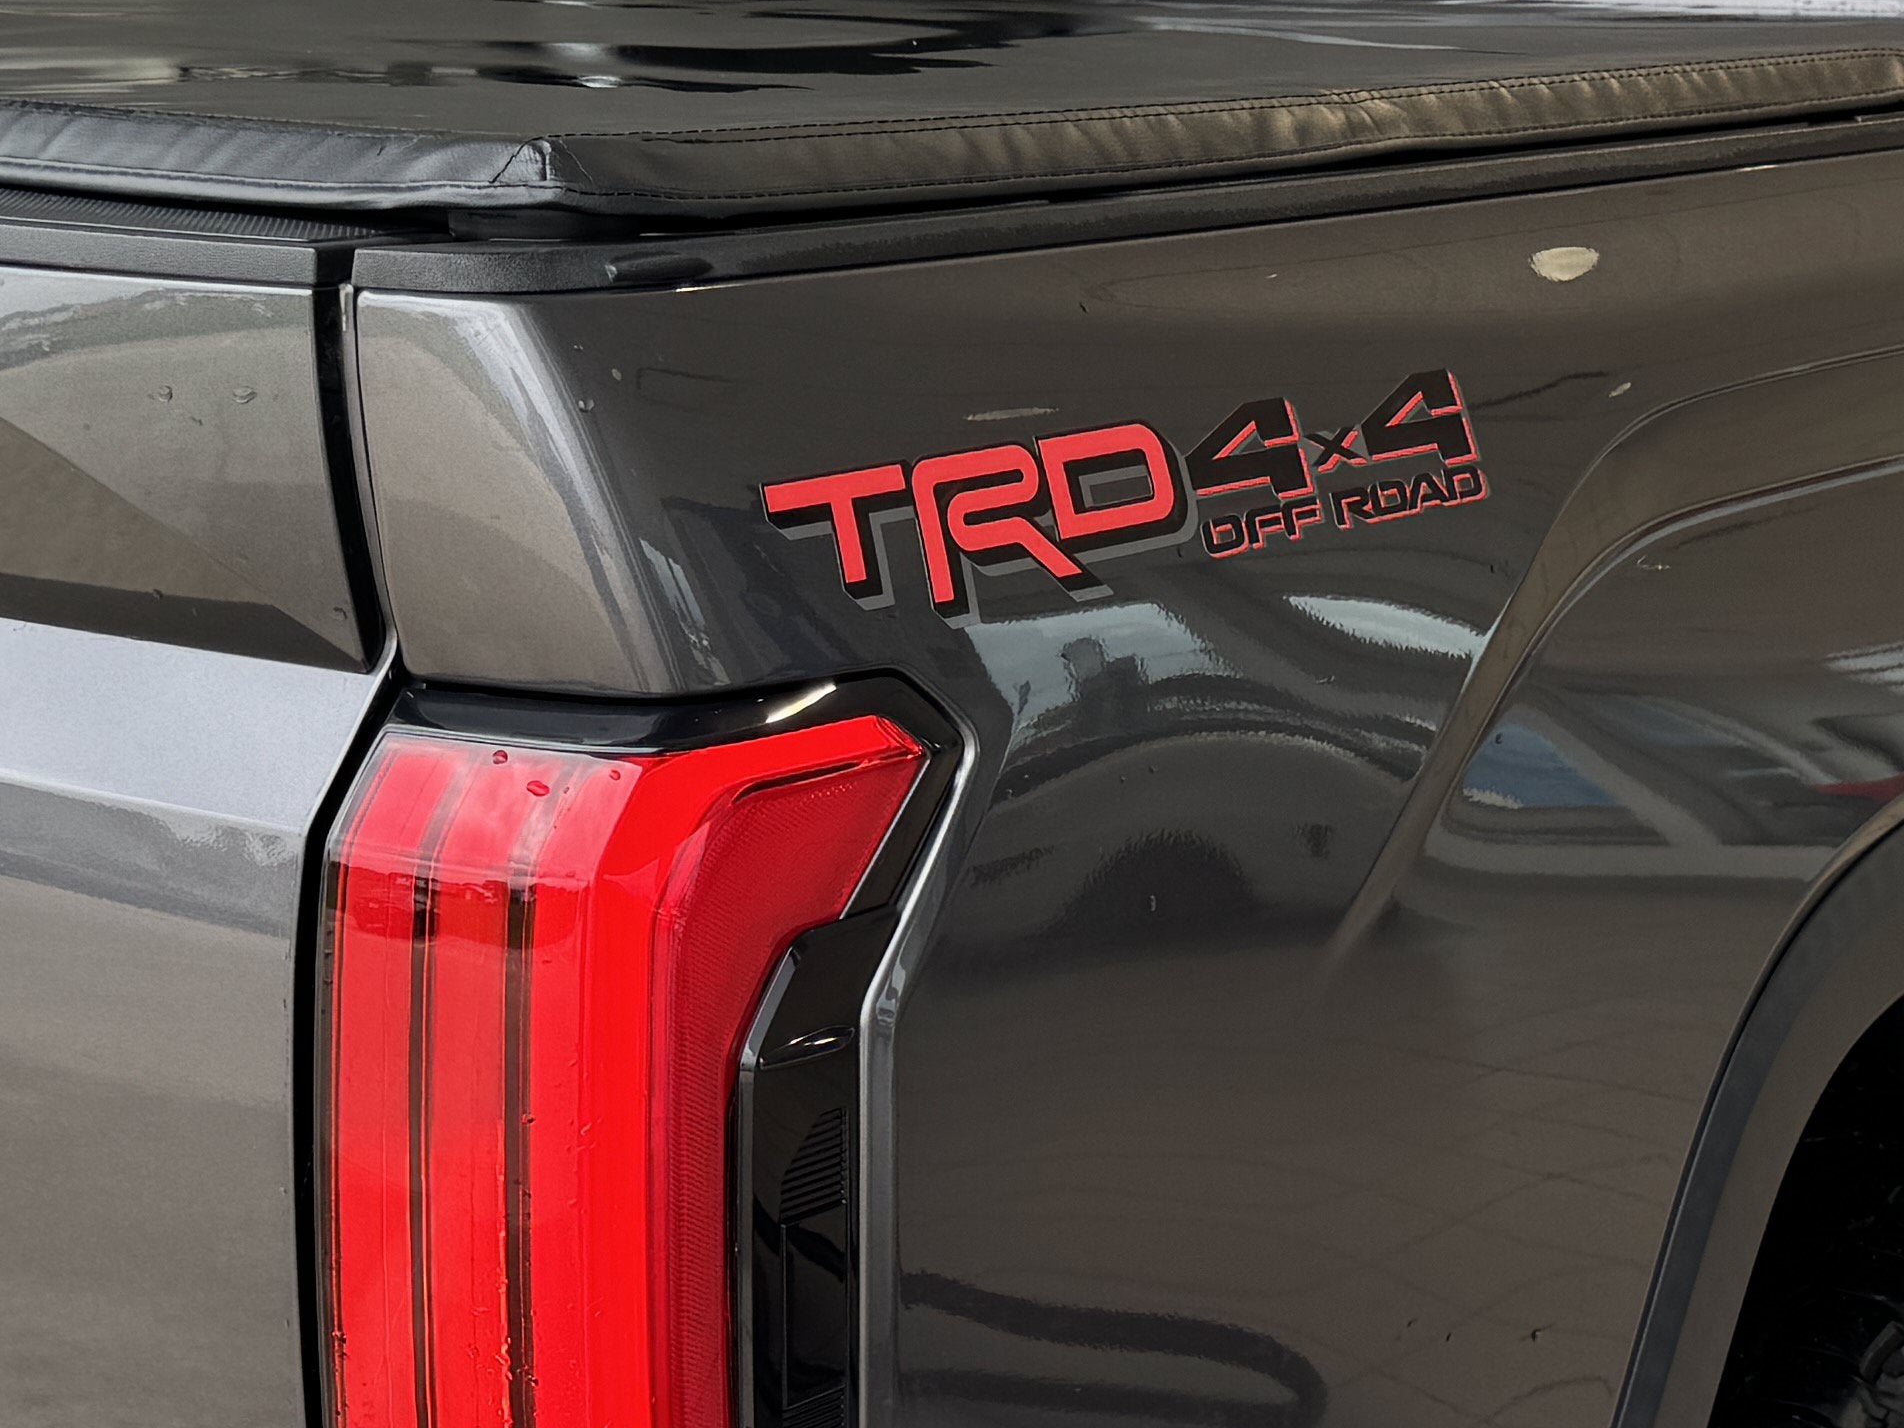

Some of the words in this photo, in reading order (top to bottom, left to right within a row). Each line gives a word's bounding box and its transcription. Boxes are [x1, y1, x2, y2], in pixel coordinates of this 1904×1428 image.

[760, 421, 1186, 622] TRD
[1201, 499, 1324, 559] OFF
[1331, 465, 1490, 529] ROAD
